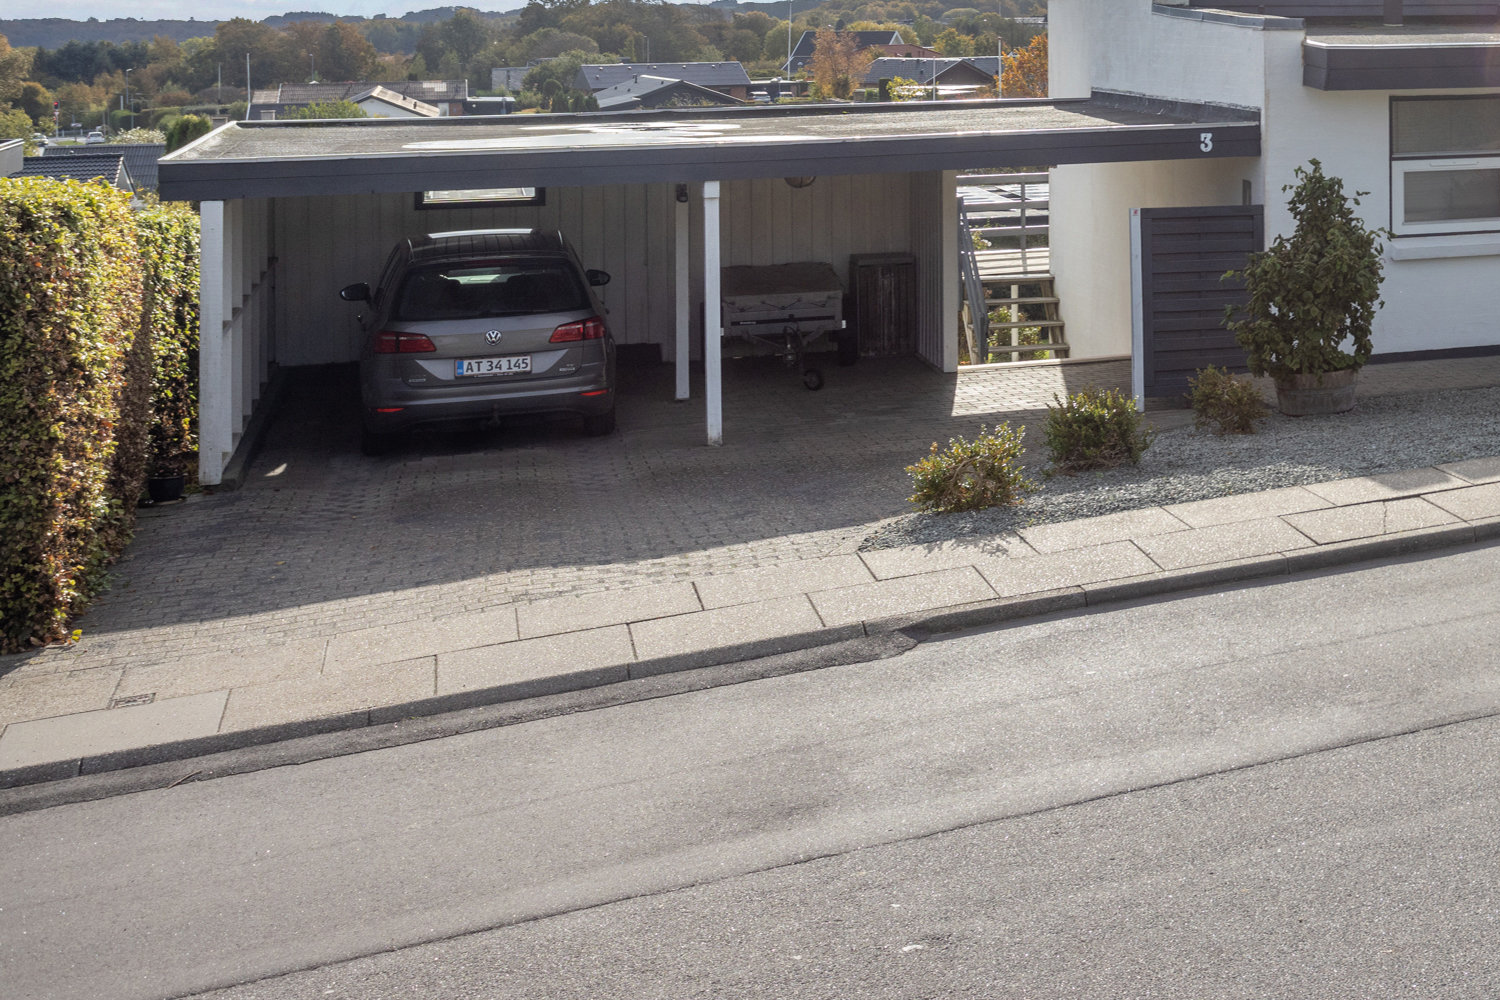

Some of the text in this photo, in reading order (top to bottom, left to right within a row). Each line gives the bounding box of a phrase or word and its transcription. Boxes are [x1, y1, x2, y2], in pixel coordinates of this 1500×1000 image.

[1200, 132, 1213, 152] 3
[465, 361, 483, 373] AT
[486, 360, 502, 371] 34
[506, 358, 529, 370] 145
